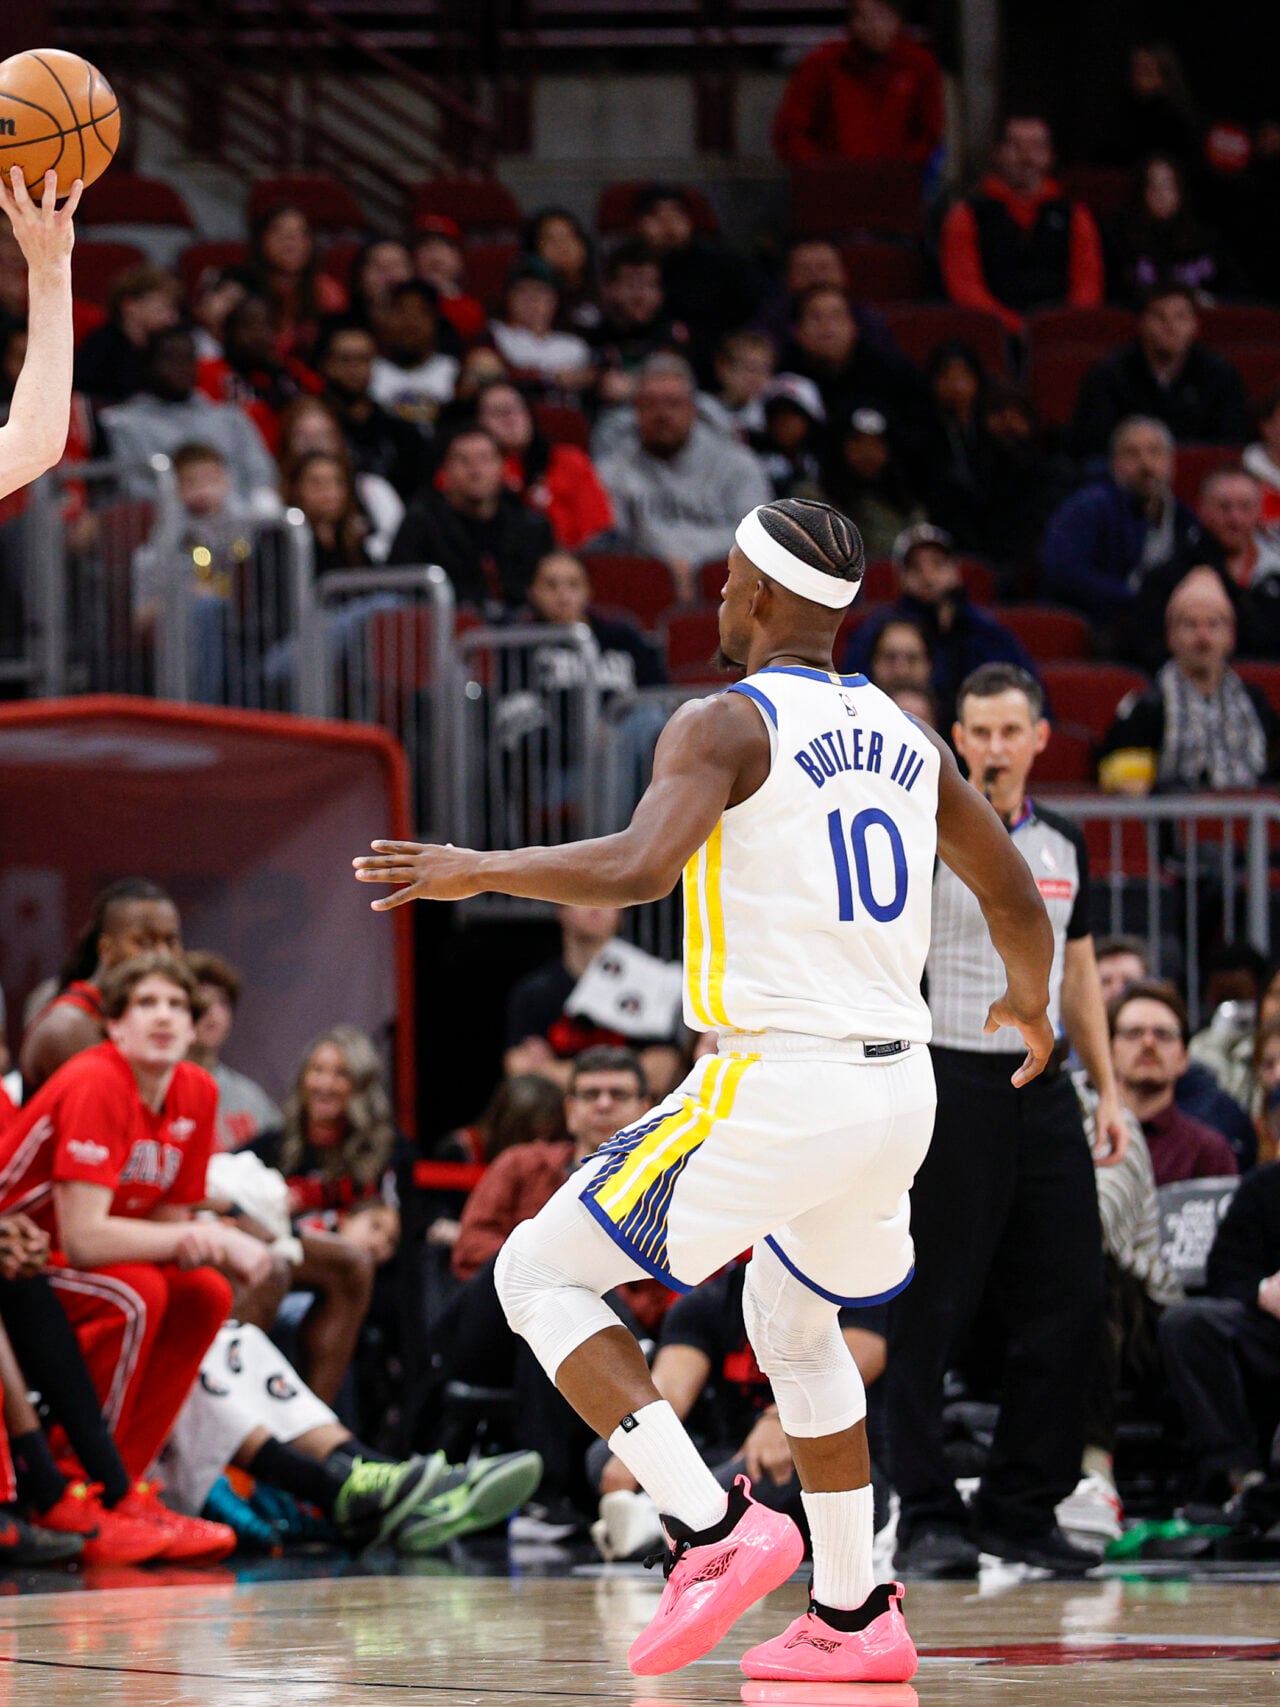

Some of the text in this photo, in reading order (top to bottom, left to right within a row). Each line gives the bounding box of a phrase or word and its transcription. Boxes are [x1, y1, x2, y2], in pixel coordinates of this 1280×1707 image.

[793, 728, 925, 793] BUTLER III
[827, 807, 909, 923] 10
